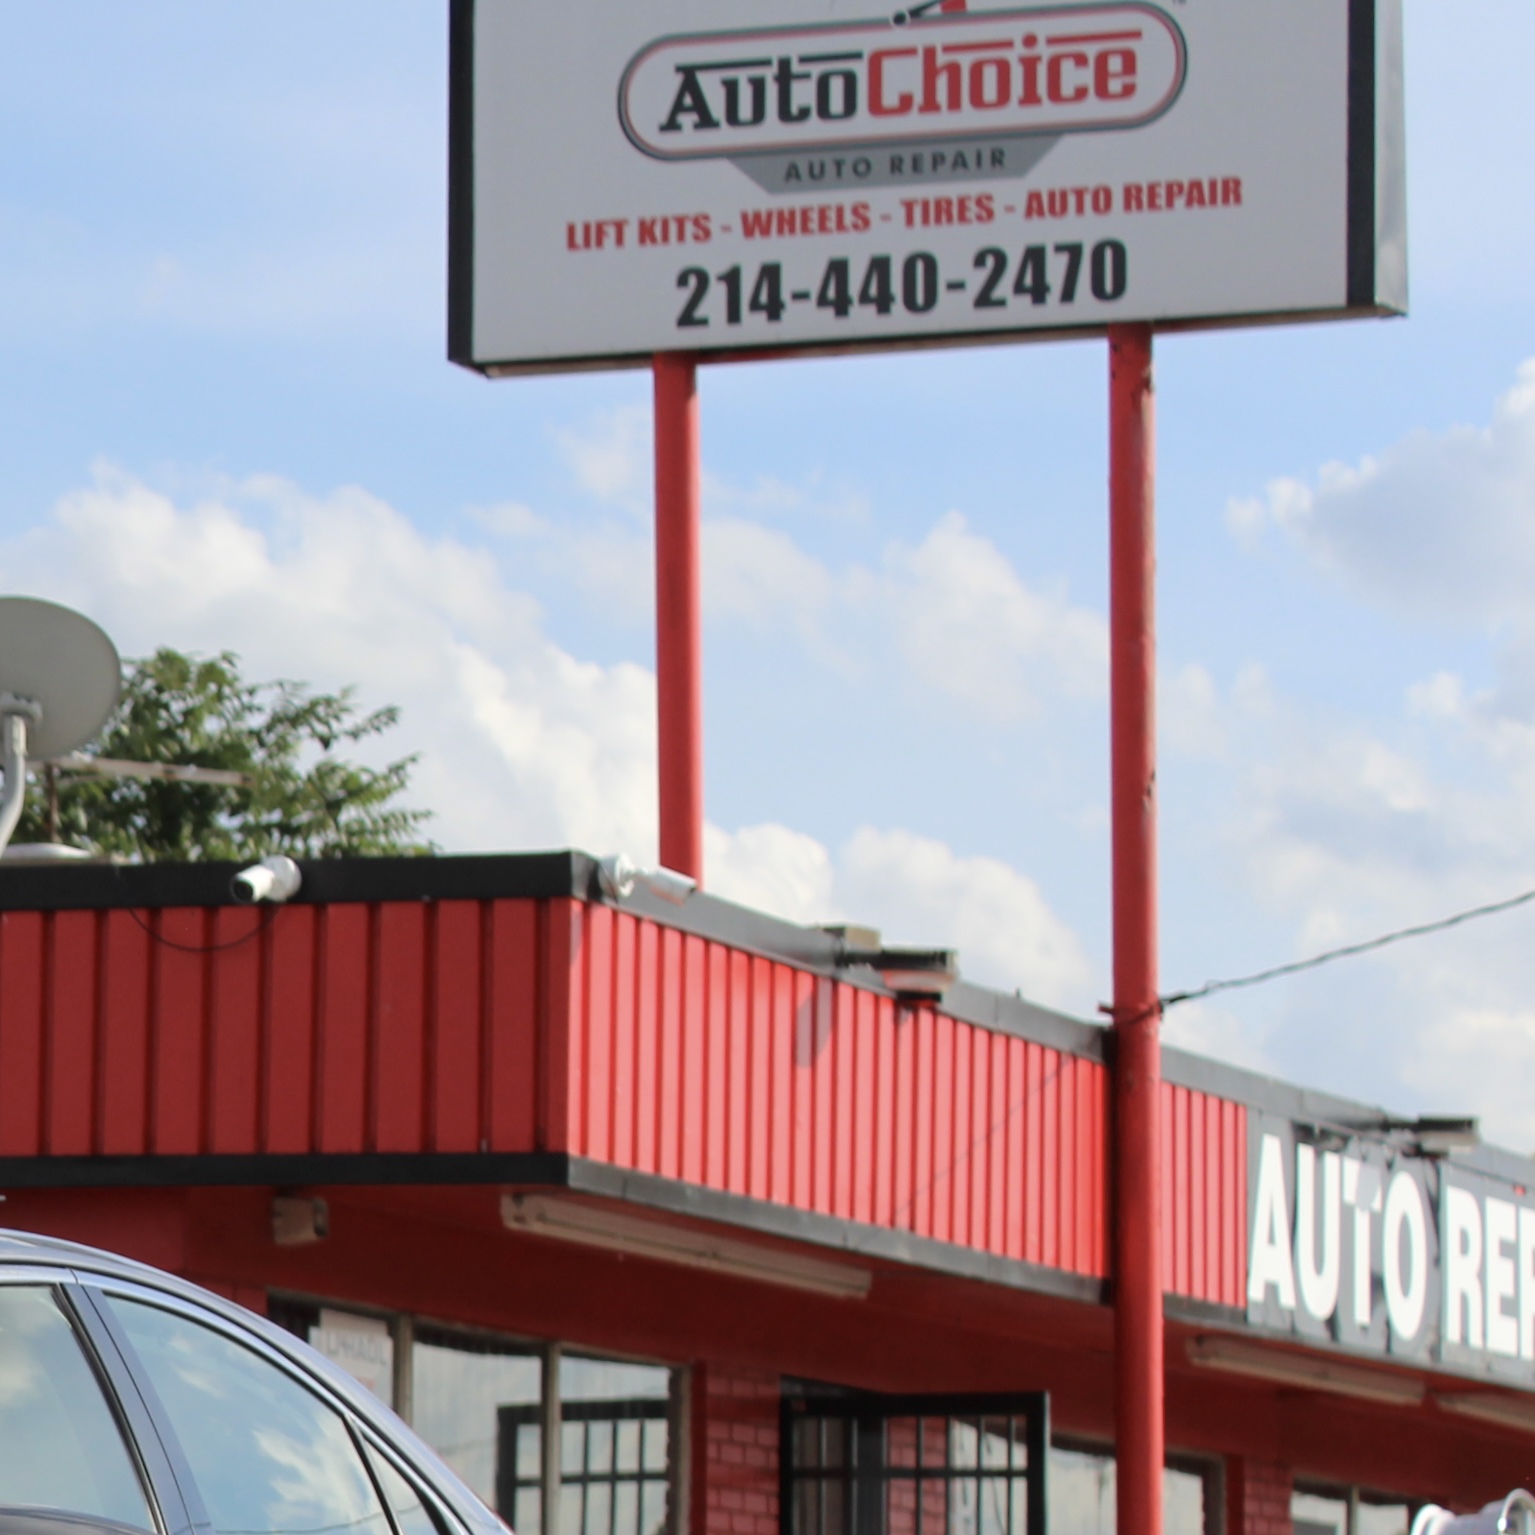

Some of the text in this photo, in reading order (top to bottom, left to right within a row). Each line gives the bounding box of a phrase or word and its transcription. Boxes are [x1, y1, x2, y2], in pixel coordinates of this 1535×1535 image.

[659, 30, 1142, 132] AutoChoice
[785, 147, 1006, 183] AUTO REPAIR
[566, 219, 629, 250] LIFT
[638, 213, 712, 246] KITS
[740, 202, 871, 239] WHEELS
[900, 194, 995, 228] TIRES
[1025, 186, 1113, 220] AUTO
[1123, 177, 1243, 213] REPAIR
[675, 239, 1127, 327] 214-440-2470
[1247, 1133, 1427, 1341] AUTO
